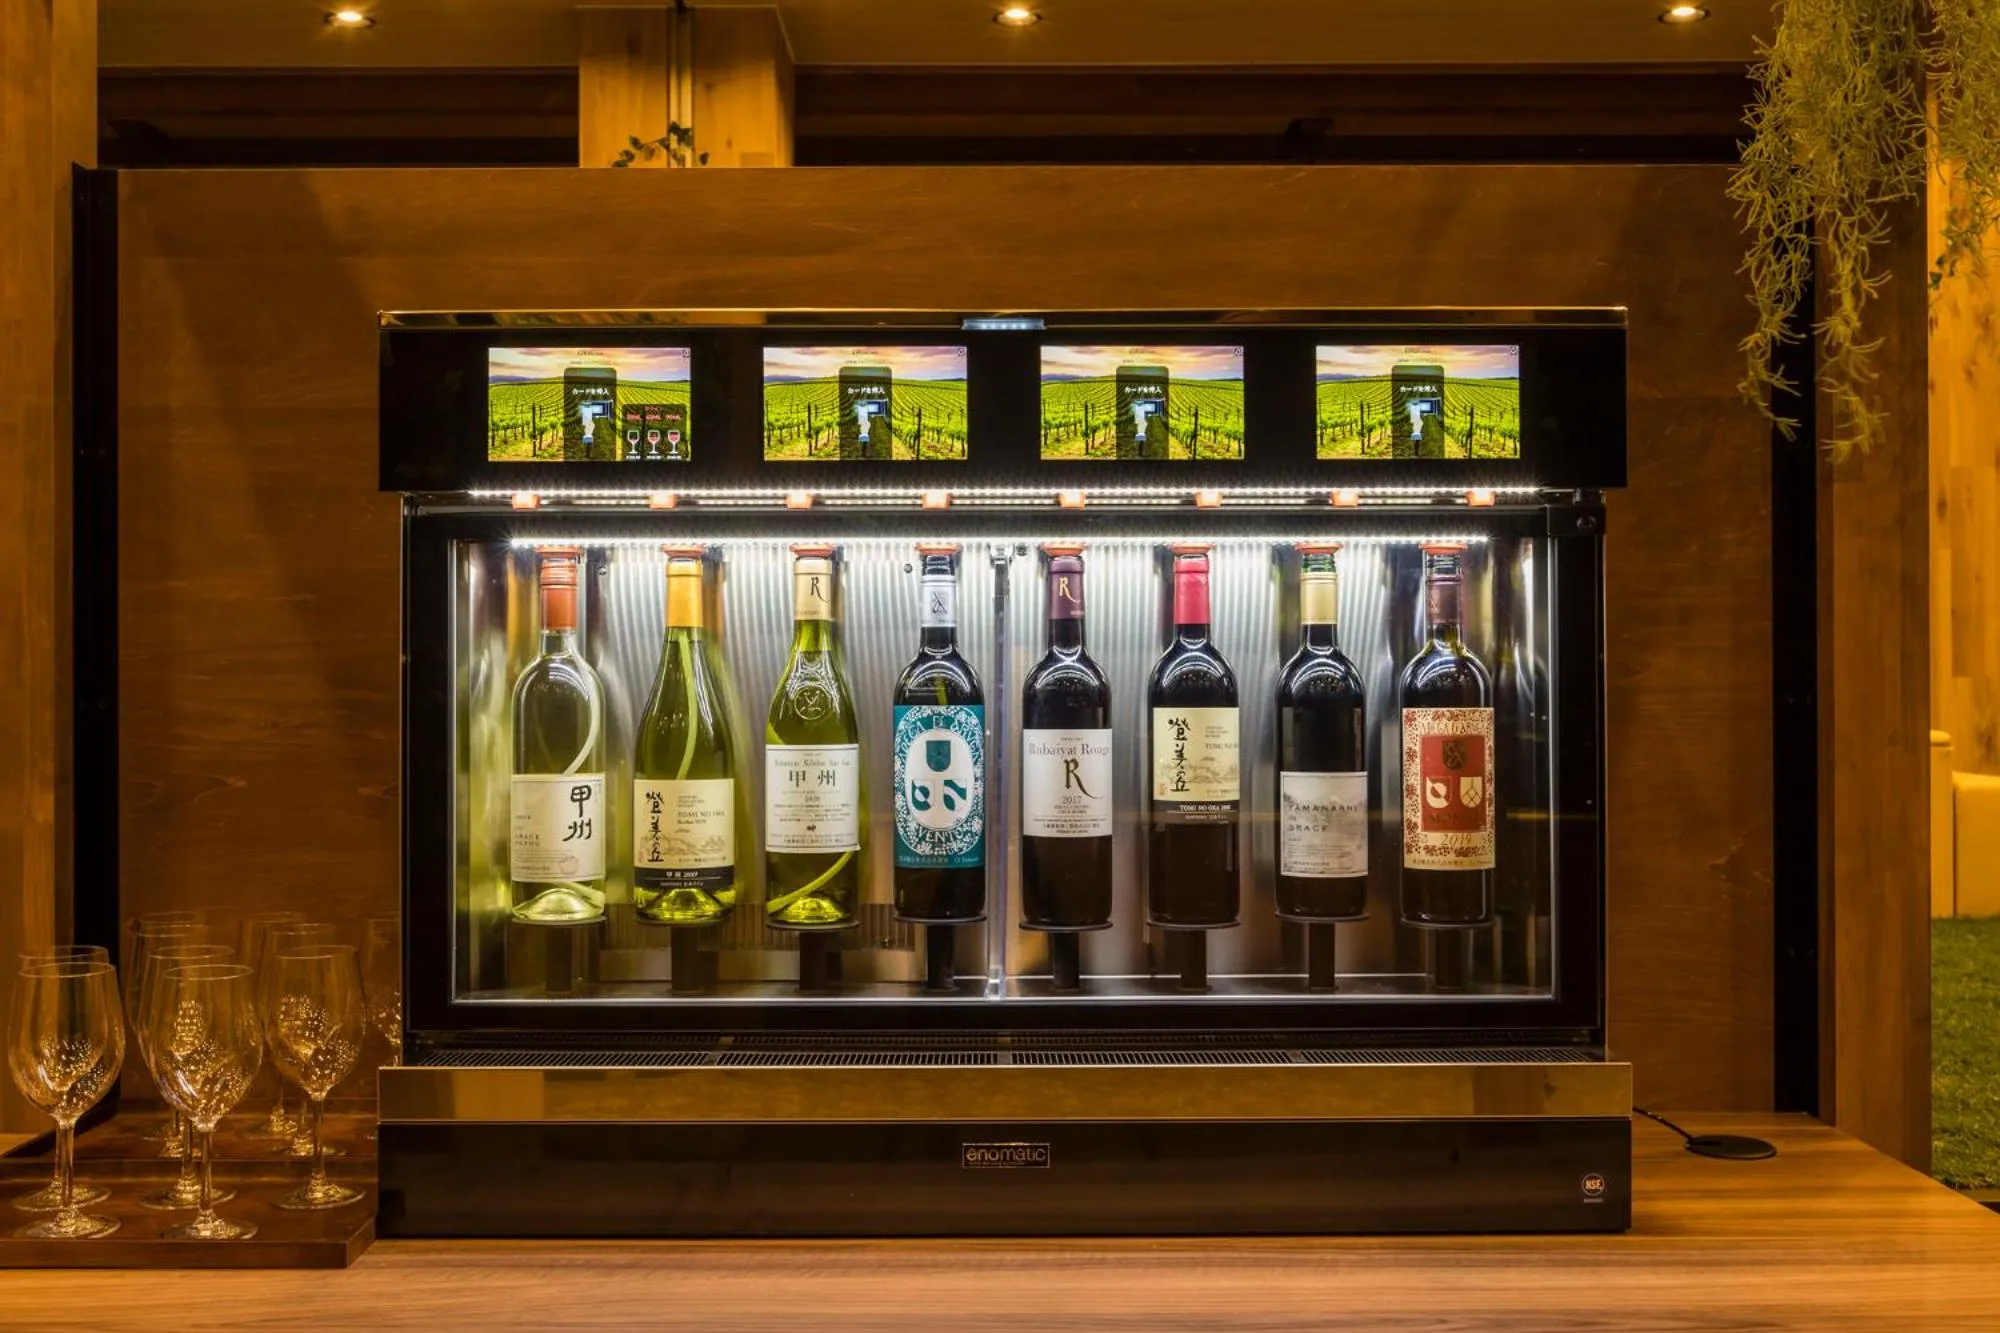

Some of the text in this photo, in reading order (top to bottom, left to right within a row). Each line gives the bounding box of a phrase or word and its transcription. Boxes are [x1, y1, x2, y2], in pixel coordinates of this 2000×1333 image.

[789, 769, 836, 788] 甲州
[562, 784, 592, 842] 甲州
[966, 1147, 1047, 1161] enomatic
